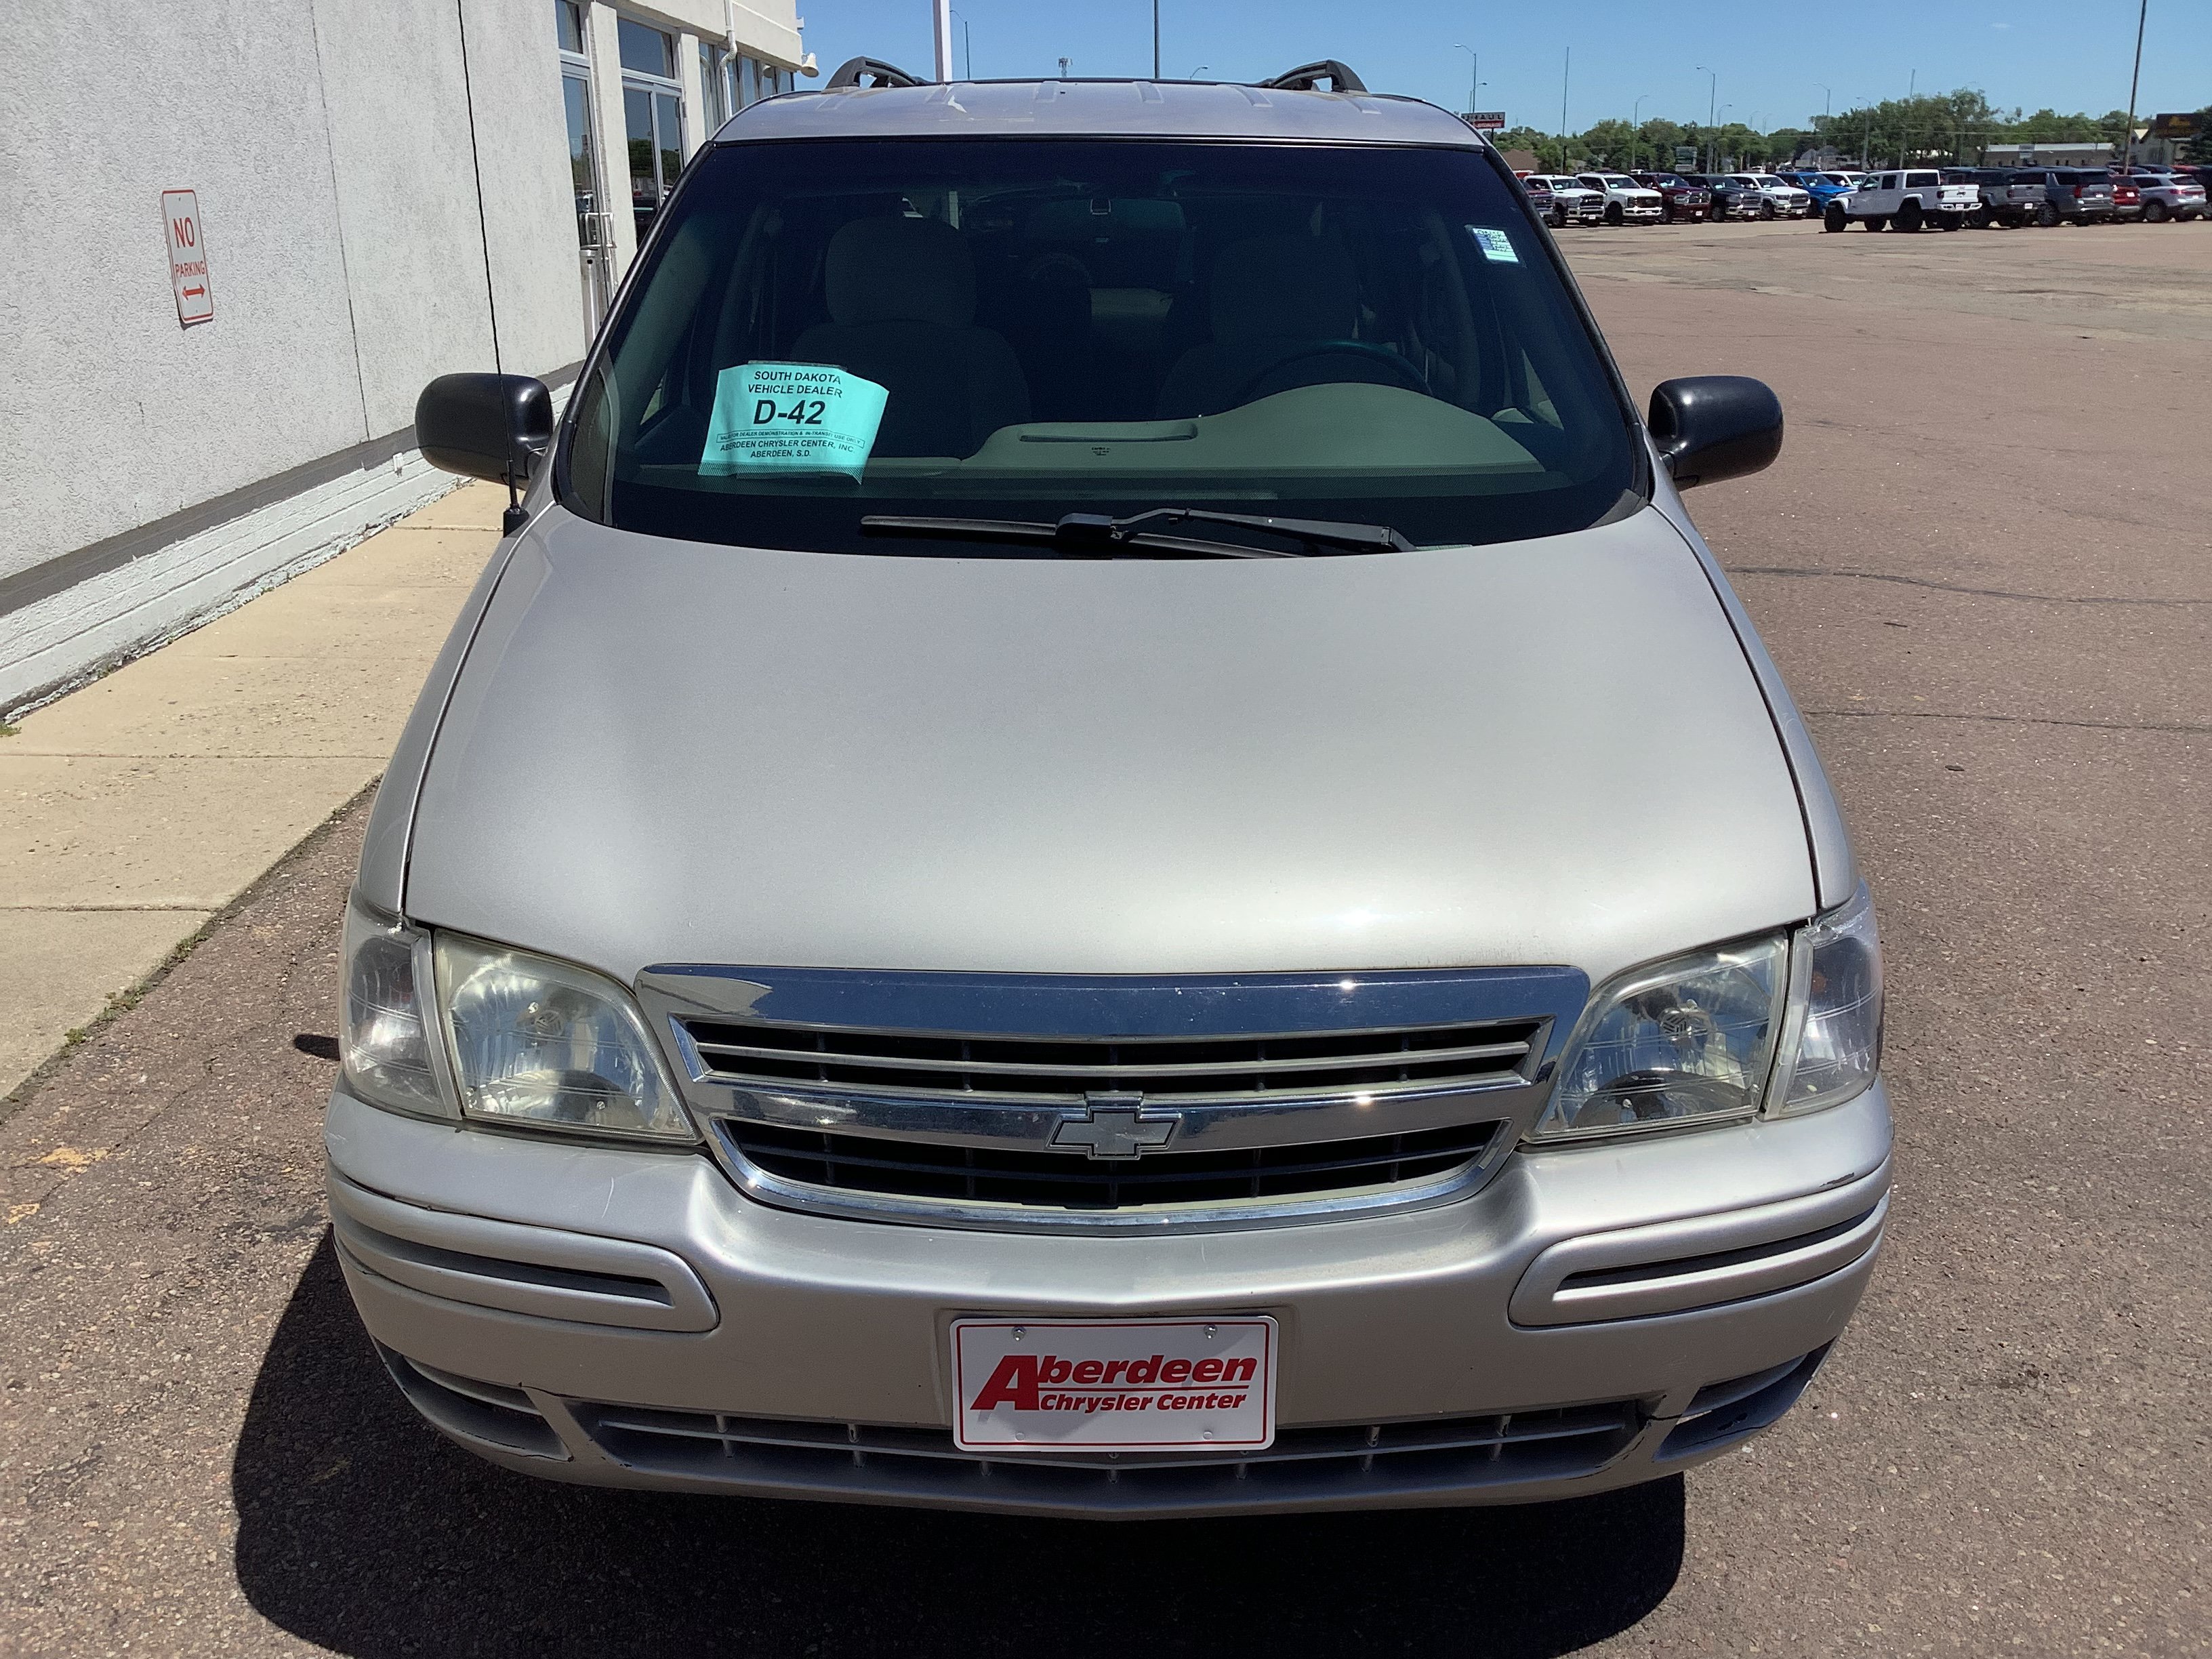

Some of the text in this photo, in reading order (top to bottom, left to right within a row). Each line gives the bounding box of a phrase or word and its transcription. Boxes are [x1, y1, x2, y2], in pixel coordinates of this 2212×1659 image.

[173, 217, 194, 248] NO
[175, 260, 205, 278] PARKING
[754, 371, 841, 384] SOUTH DAKOTA
[747, 384, 843, 398] VEHICLE DEALER
[753, 399, 825, 425] D-42
[720, 441, 756, 451] ABERDEEN
[758, 440, 799, 448] CHRYSLER
[800, 440, 836, 449] CENTER,
[750, 449, 794, 458] ABERDEEN,
[970, 1354, 1258, 1411] Aberdeen
[1040, 1393, 1246, 1414] Chrysler Center
